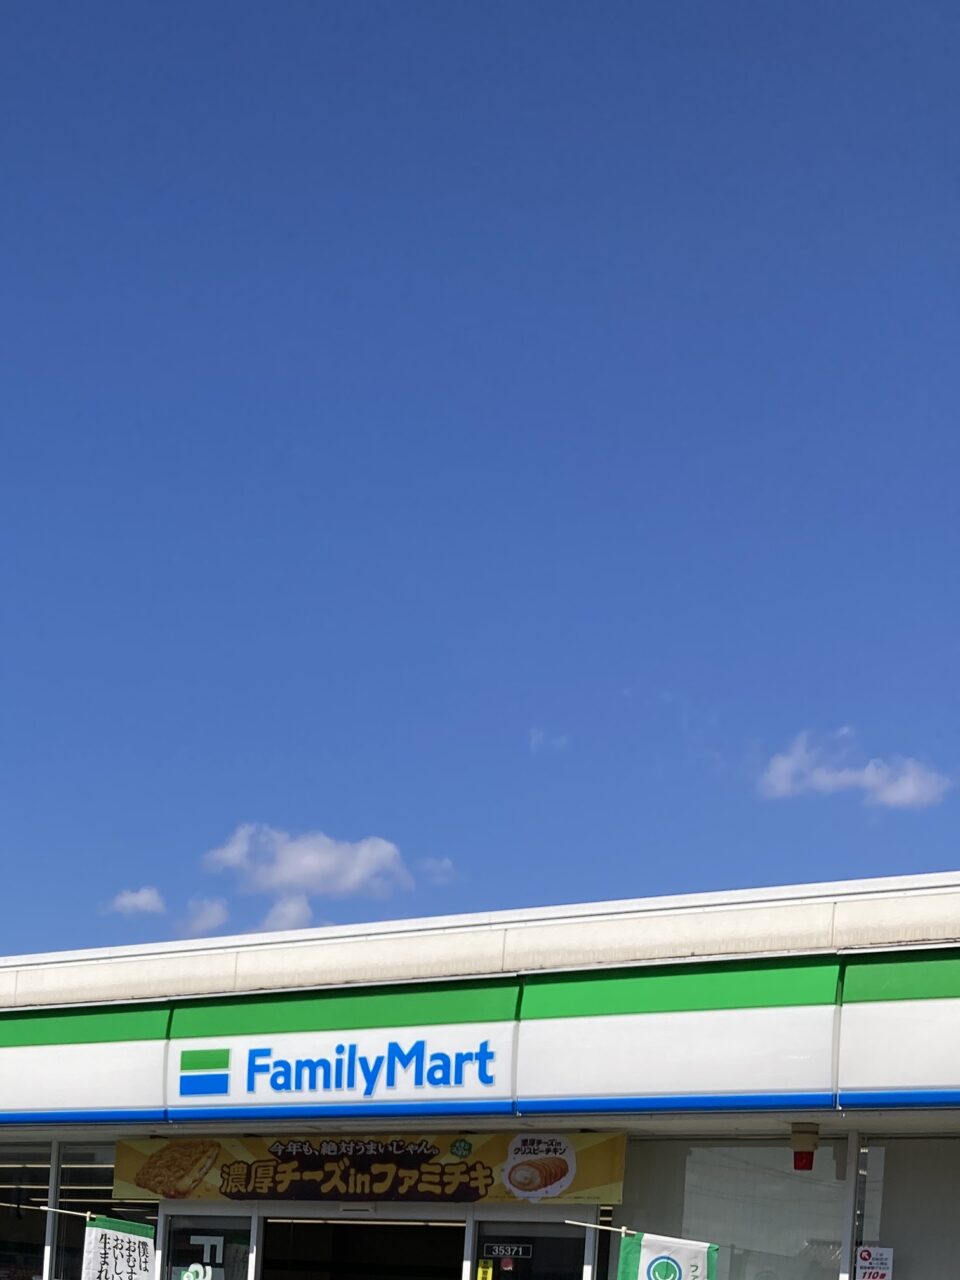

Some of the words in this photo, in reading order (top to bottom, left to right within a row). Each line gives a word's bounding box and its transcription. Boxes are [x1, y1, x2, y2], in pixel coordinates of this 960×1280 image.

[247, 1040, 494, 1097] FamilyMart
[271, 1140, 439, 1157] 今年も、絶対うまいじゃん。
[513, 1146, 568, 1156] クリスピーチキン
[520, 1138, 562, 1147] 濃厚チーズin
[221, 1158, 493, 1197] 濃厚チーズinファミチキ
[138, 1241, 149, 1272] 僕は
[492, 1246, 522, 1255] 35371
